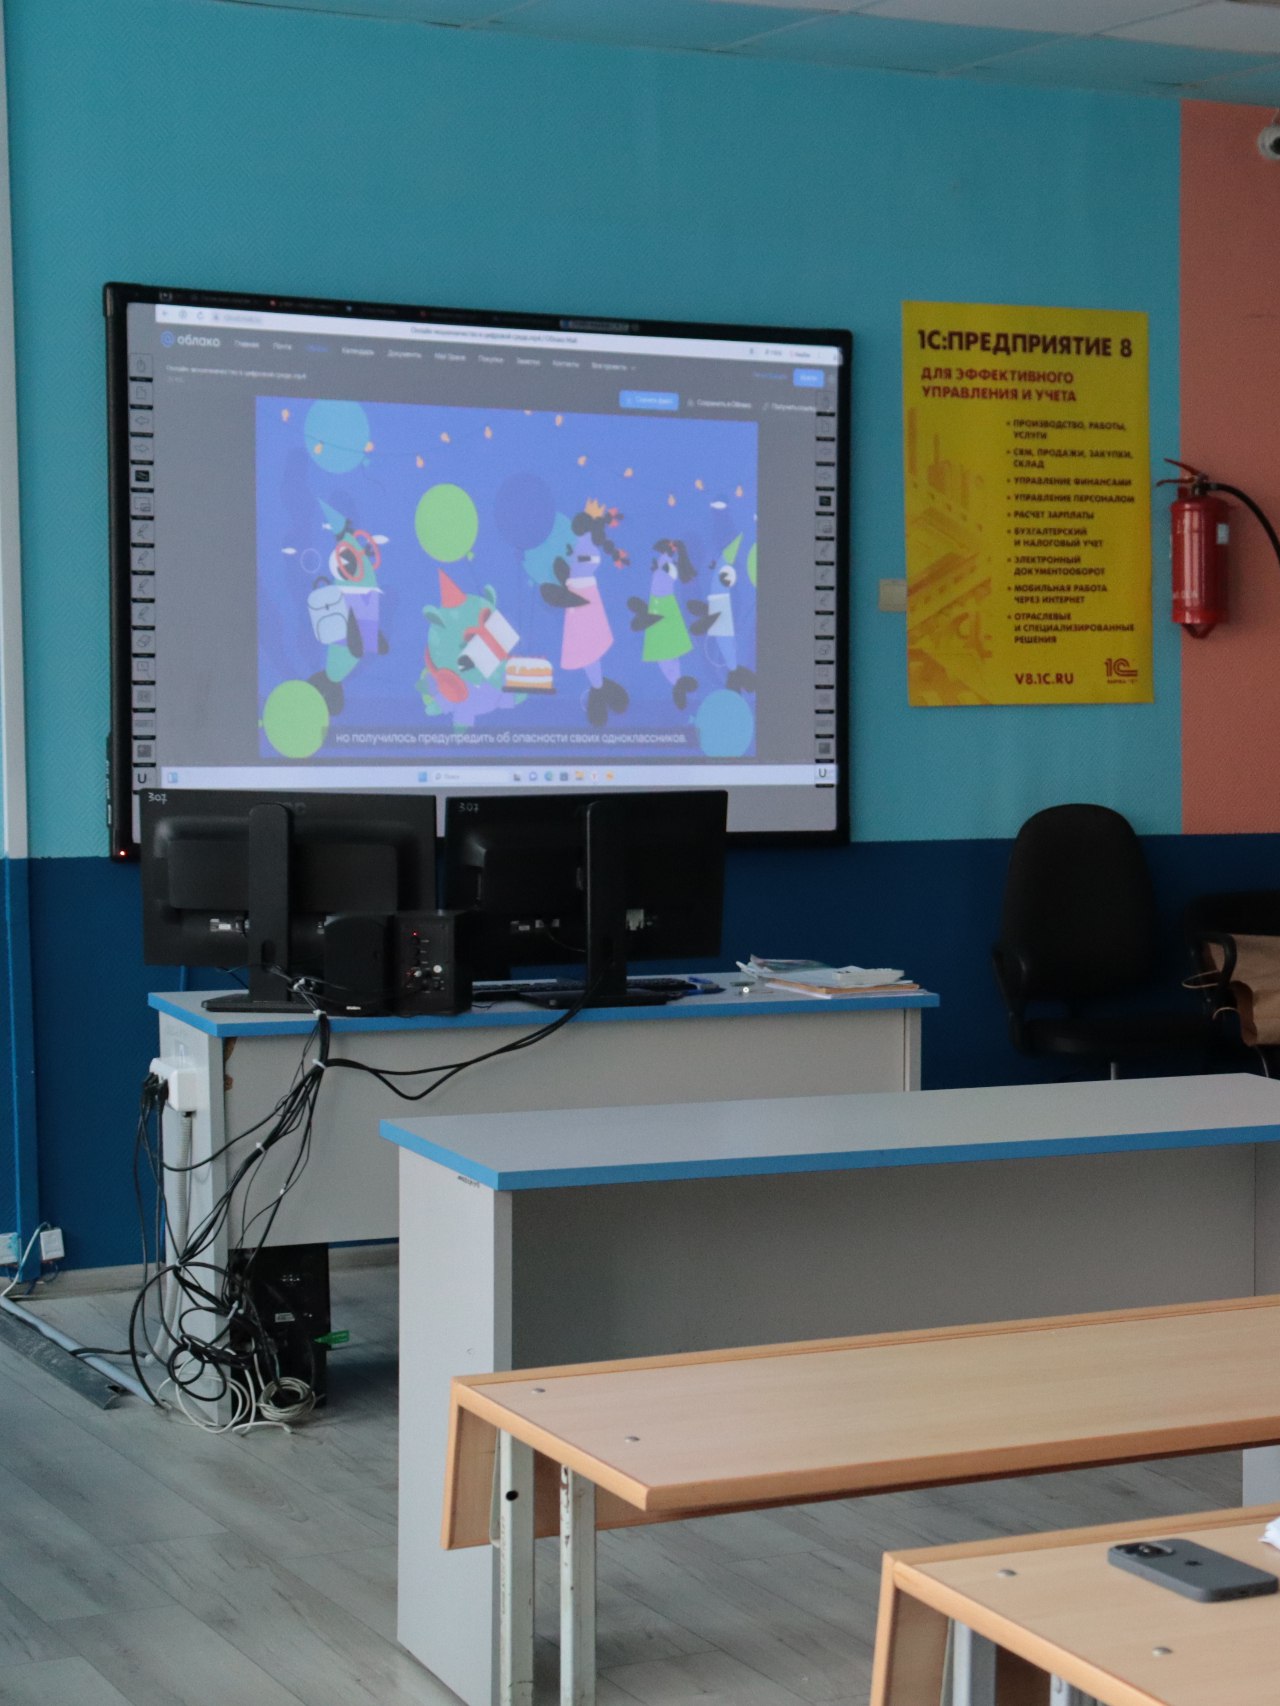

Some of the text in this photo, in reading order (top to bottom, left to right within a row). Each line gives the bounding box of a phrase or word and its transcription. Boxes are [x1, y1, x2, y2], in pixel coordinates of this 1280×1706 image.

[177, 334, 221, 348] облако
[918, 330, 1132, 357] 1С:ПРЕДПРИЯТИЕ 8
[921, 367, 1073, 383] ДЛЯ ЭФФЕКТИВНОГО
[922, 386, 1076, 402] УПРАВЛЕНИЯ И УЧЕТА
[1014, 477, 1132, 486] УПРАВЛЕНИЕ ФИНАНСАМИ
[1015, 494, 1134, 503] УПРАВЛЕНИЕ ПЕРСОНАЛОМ
[1014, 511, 1094, 520] РАСЧЕТ ЗАРПЛАТЫ
[1014, 527, 1087, 536] БУХГАЛТЕРСКИЙ
[1014, 539, 1021, 547] И
[1014, 555, 1081, 564] ЭЛЕКТРОННЫЙ
[1015, 584, 1107, 592] МОБИЛЬНАЯ РАБОТА
[1015, 596, 1085, 604] ЧЕРЕЗ ИНТЕРНЕТ
[1015, 613, 1071, 621] ОТРАСЛЕВЫЕ
[1023, 624, 1134, 633] СПЕЦИАЛИЗИРОВАННЫЕ
[1015, 635, 1057, 644] РЕШЕНИЯ
[1015, 673, 1074, 685] V8.1C.RU
[336, 733, 350, 744] но
[352, 733, 416, 745] получилось
[418, 733, 494, 746] предупредить
[496, 731, 511, 743] об
[512, 733, 568, 744] опасности
[570, 733, 600, 744] своих
